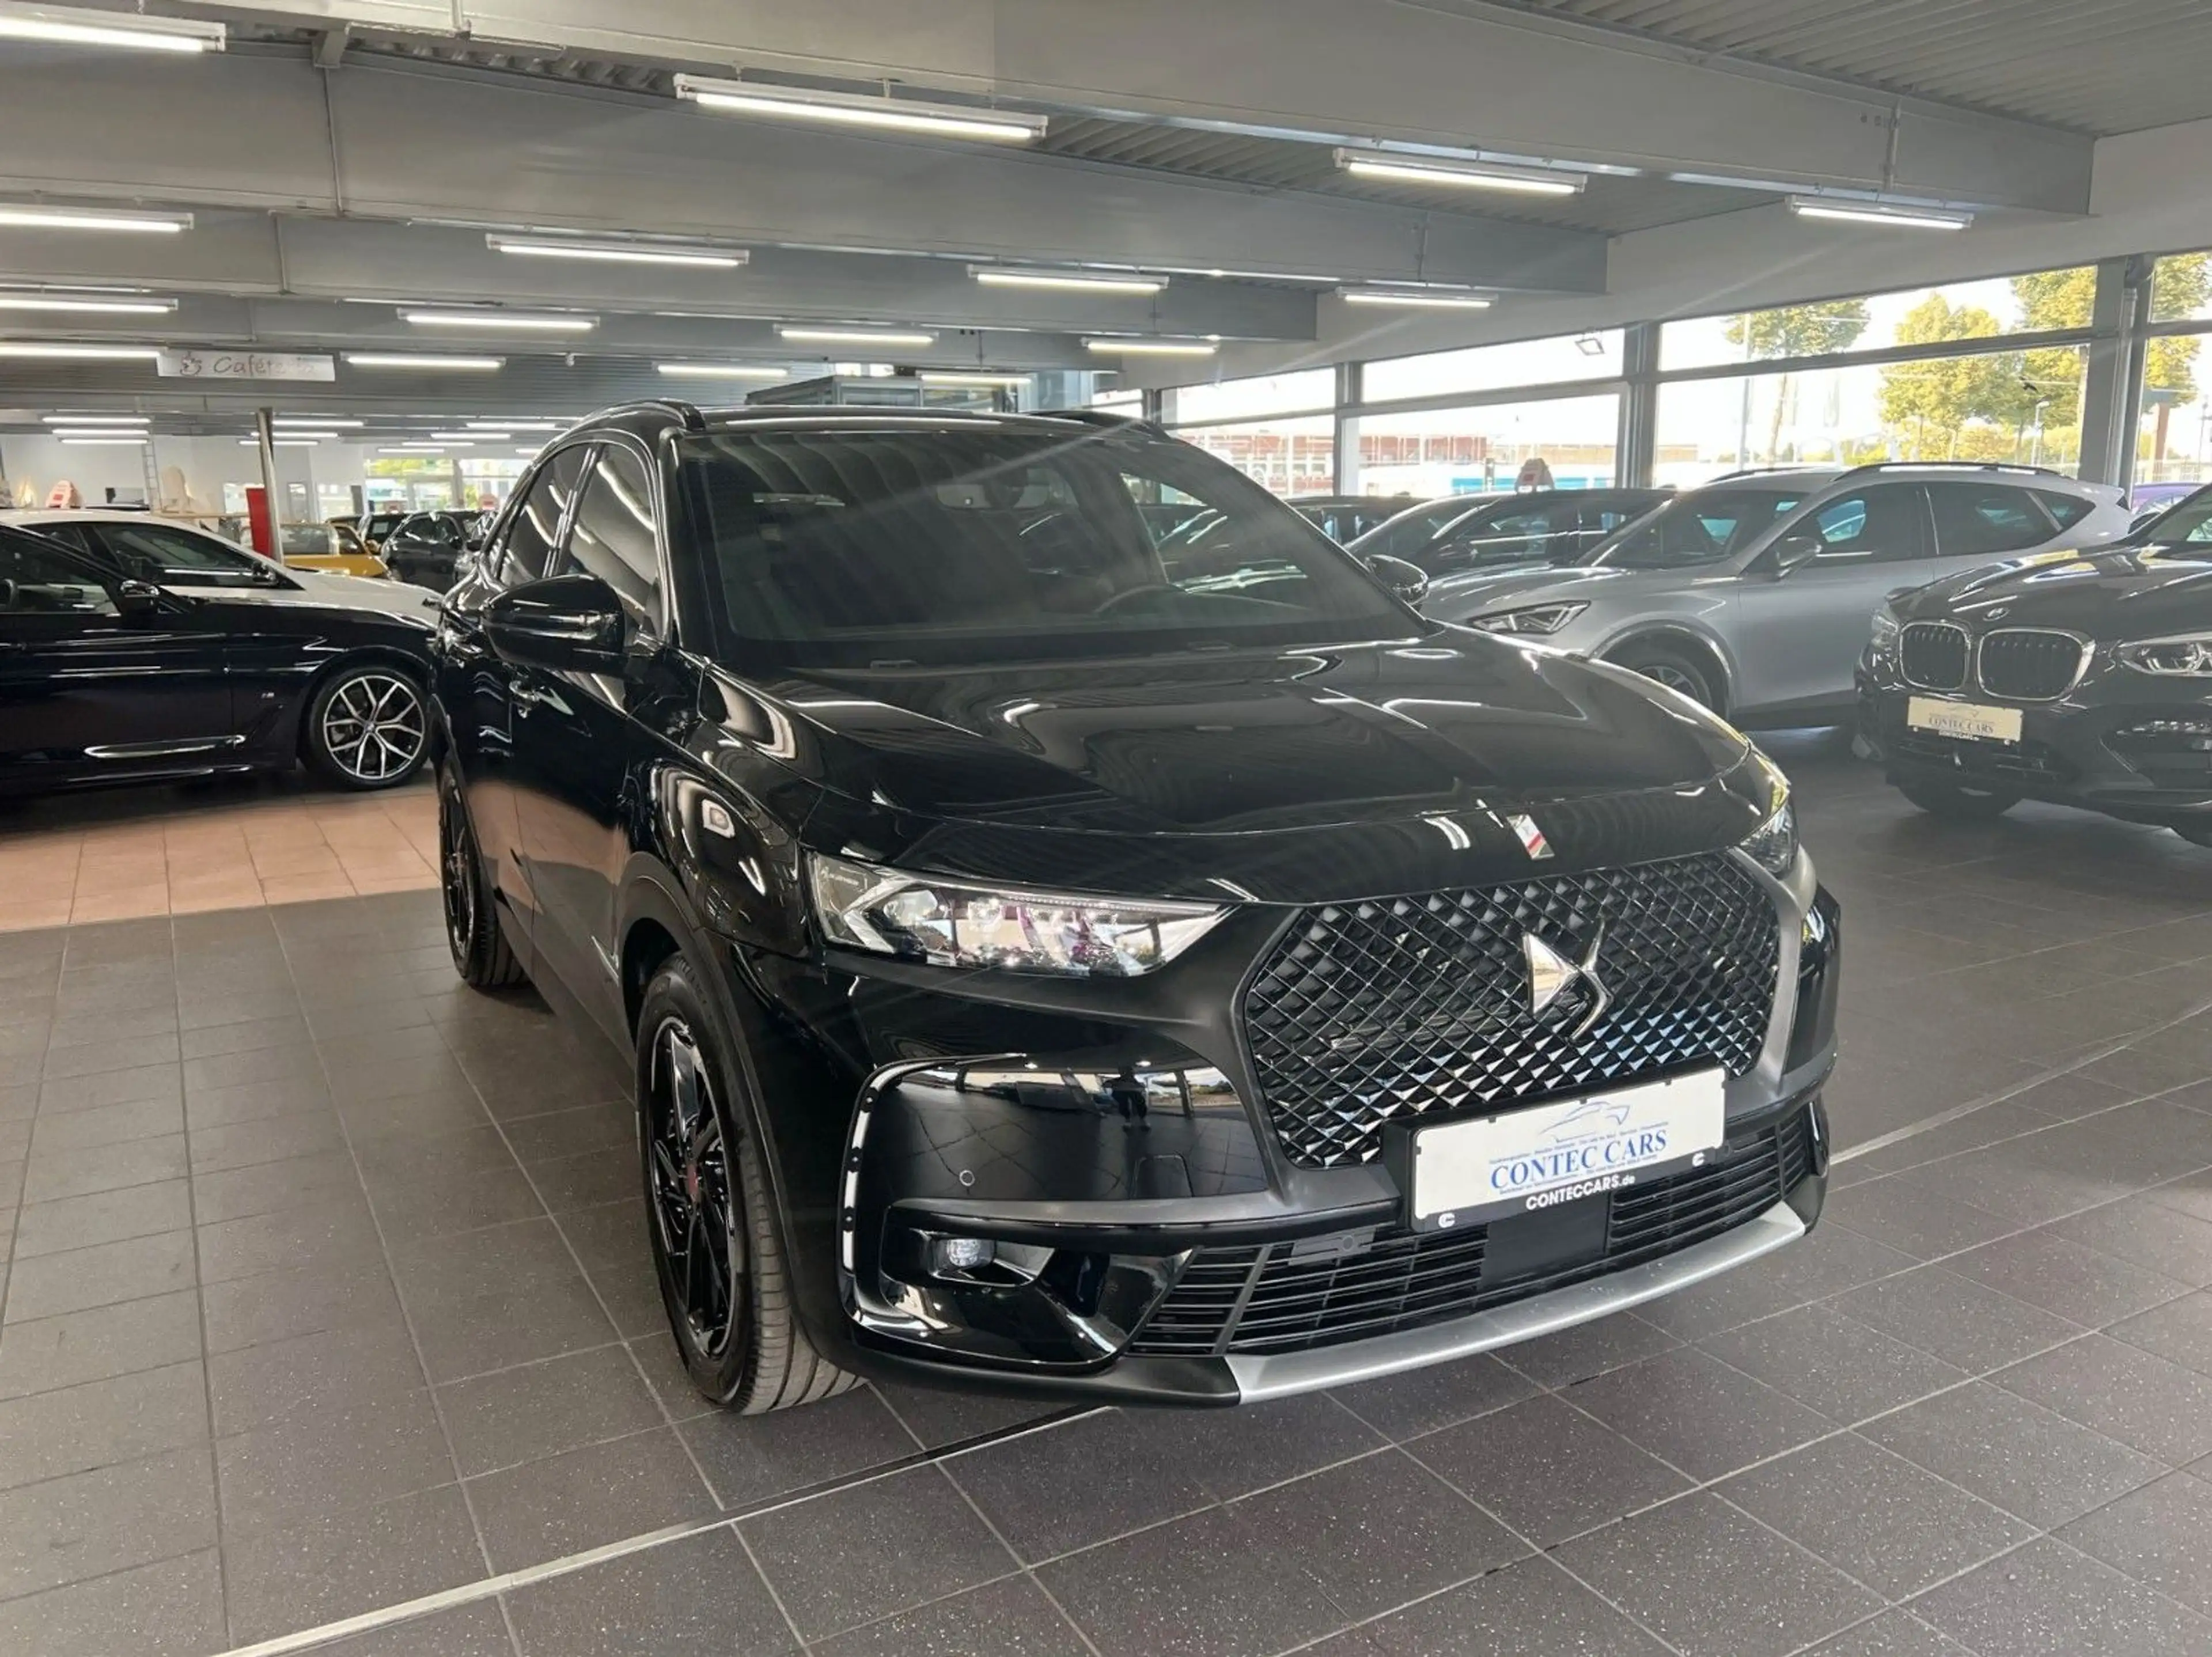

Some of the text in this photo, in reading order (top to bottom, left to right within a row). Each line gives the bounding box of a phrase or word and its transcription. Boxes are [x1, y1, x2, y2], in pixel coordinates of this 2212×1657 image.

[1491, 1146, 1597, 1188] CONTEC
[1605, 1129, 1666, 1163] CARS
[1526, 1173, 1635, 1210] CONTECCARS.de
